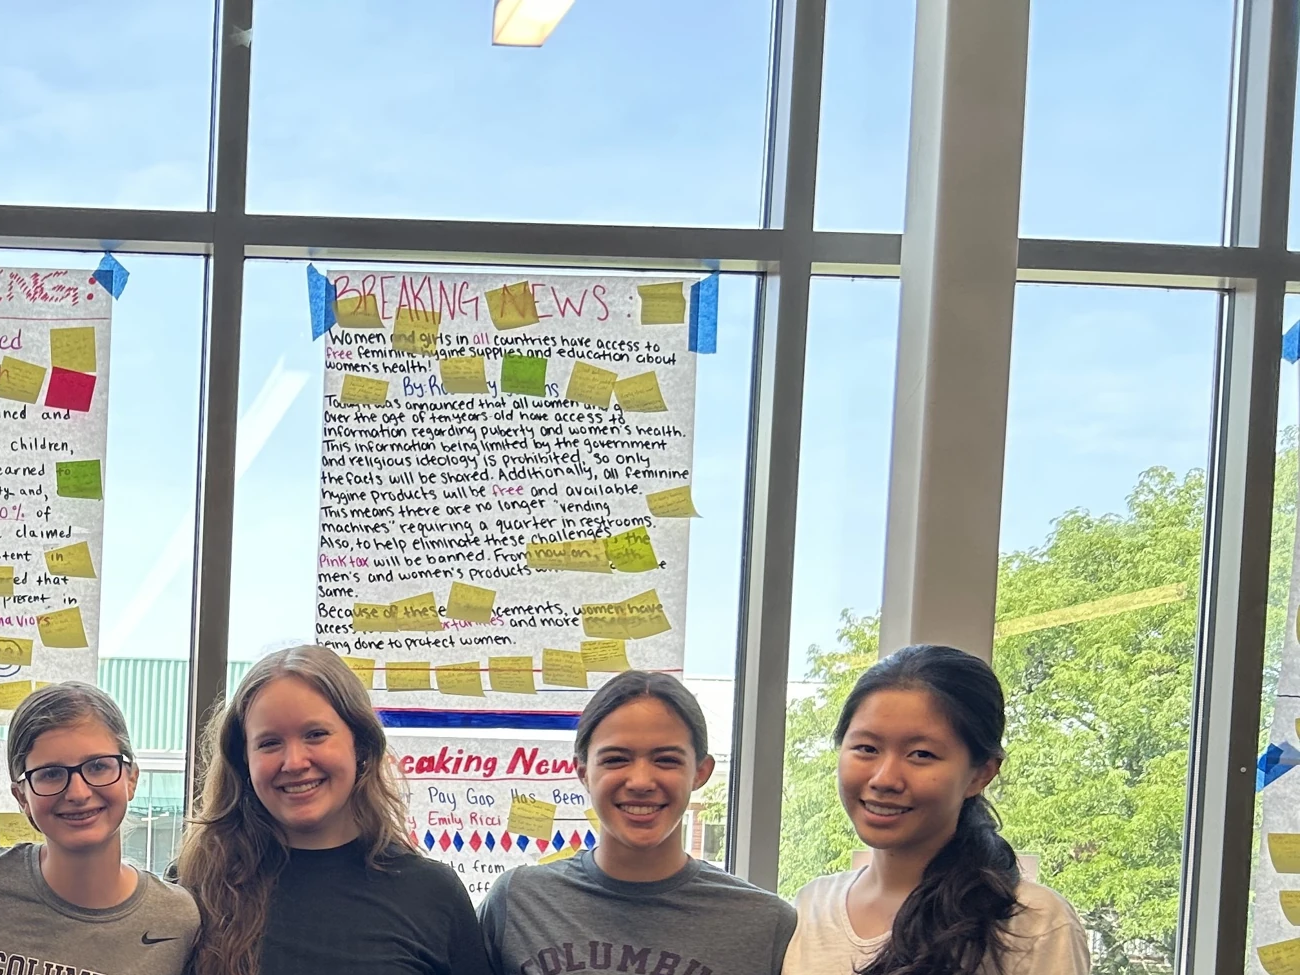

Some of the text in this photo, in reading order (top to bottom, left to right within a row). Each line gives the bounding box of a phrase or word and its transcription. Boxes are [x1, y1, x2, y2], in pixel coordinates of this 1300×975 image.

[334, 274, 479, 325] BREAKING
[329, 327, 386, 345] Women
[456, 333, 469, 345] in
[473, 332, 490, 345] all
[494, 333, 557, 347] countries
[560, 336, 591, 347] have
[596, 340, 639, 352] access
[645, 341, 660, 352] to
[326, 346, 676, 366] free education about
[325, 360, 432, 373] women's health!
[412, 426, 534, 441] regarding puberty
[10, 437, 74, 455] children,
[323, 437, 667, 454] This information by the government
[349, 452, 650, 470] religious ideology only
[389, 472, 414, 484] will
[419, 471, 437, 484] be
[625, 467, 689, 480] feminine
[20, 484, 48, 501] and,
[321, 483, 643, 505] hygine products free available.
[36, 507, 52, 522] of
[15, 524, 72, 539] claimed
[386, 746, 579, 778] eaking New
[427, 786, 585, 811] Pay Gap Has Been
[427, 811, 464, 831] Emily
[469, 812, 502, 827] Ricci
[472, 860, 505, 874] from
